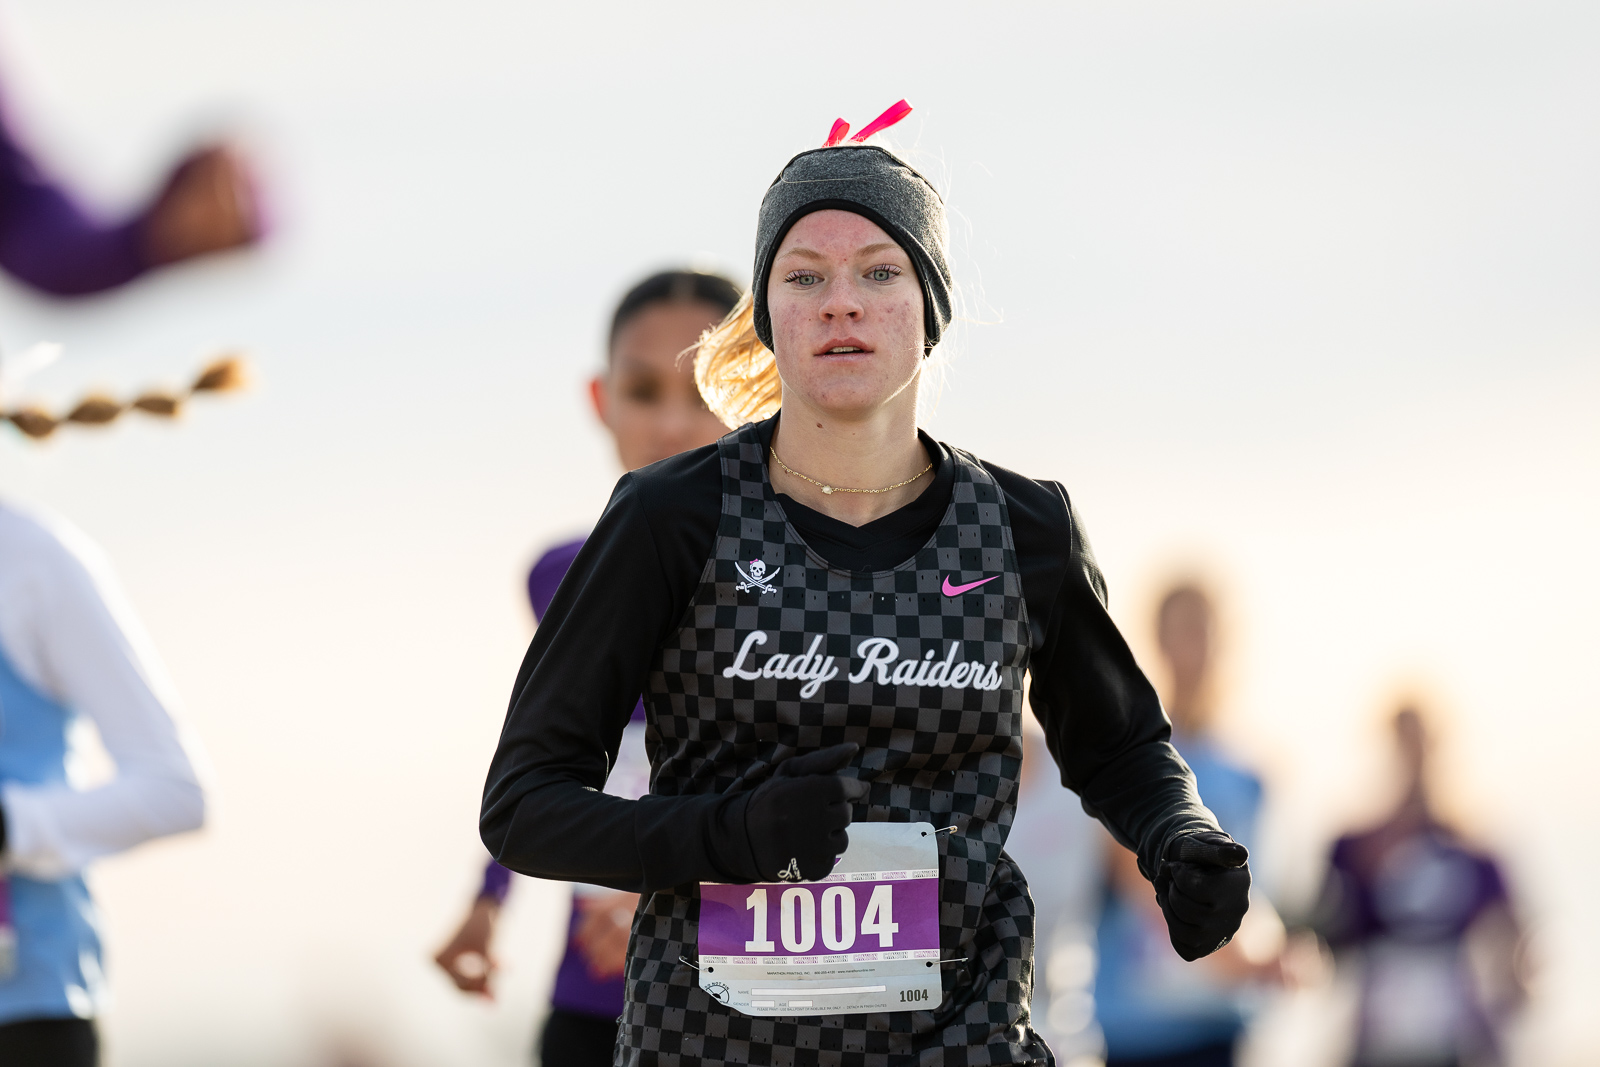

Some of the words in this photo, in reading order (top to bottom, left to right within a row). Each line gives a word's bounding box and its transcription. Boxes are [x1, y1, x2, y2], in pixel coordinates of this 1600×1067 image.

[722, 630, 839, 700] Lady
[848, 637, 1003, 691] Raiders
[745, 884, 899, 953] 1004
[900, 989, 928, 1002] 1004
